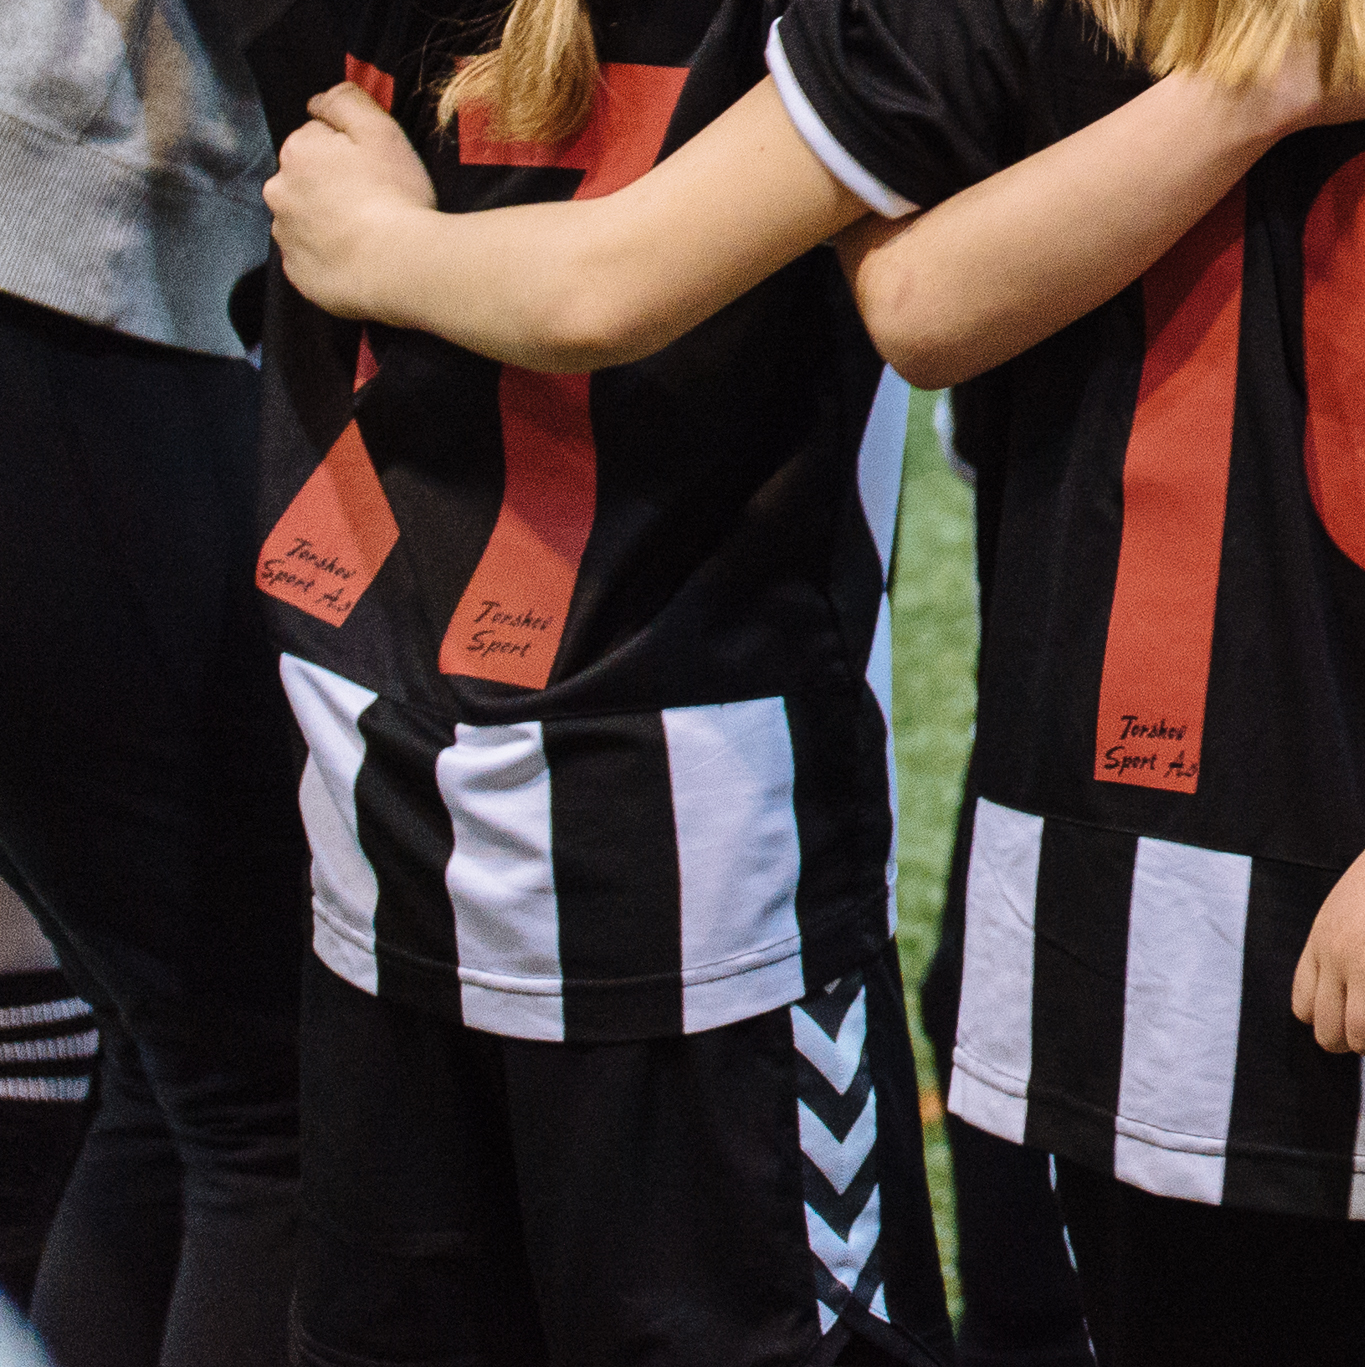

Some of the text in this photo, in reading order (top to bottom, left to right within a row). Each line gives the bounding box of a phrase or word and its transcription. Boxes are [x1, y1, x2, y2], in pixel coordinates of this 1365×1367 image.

[260, 559, 315, 592] Sport
[466, 629, 531, 658] Sport
[1103, 745, 1158, 776] Sport
